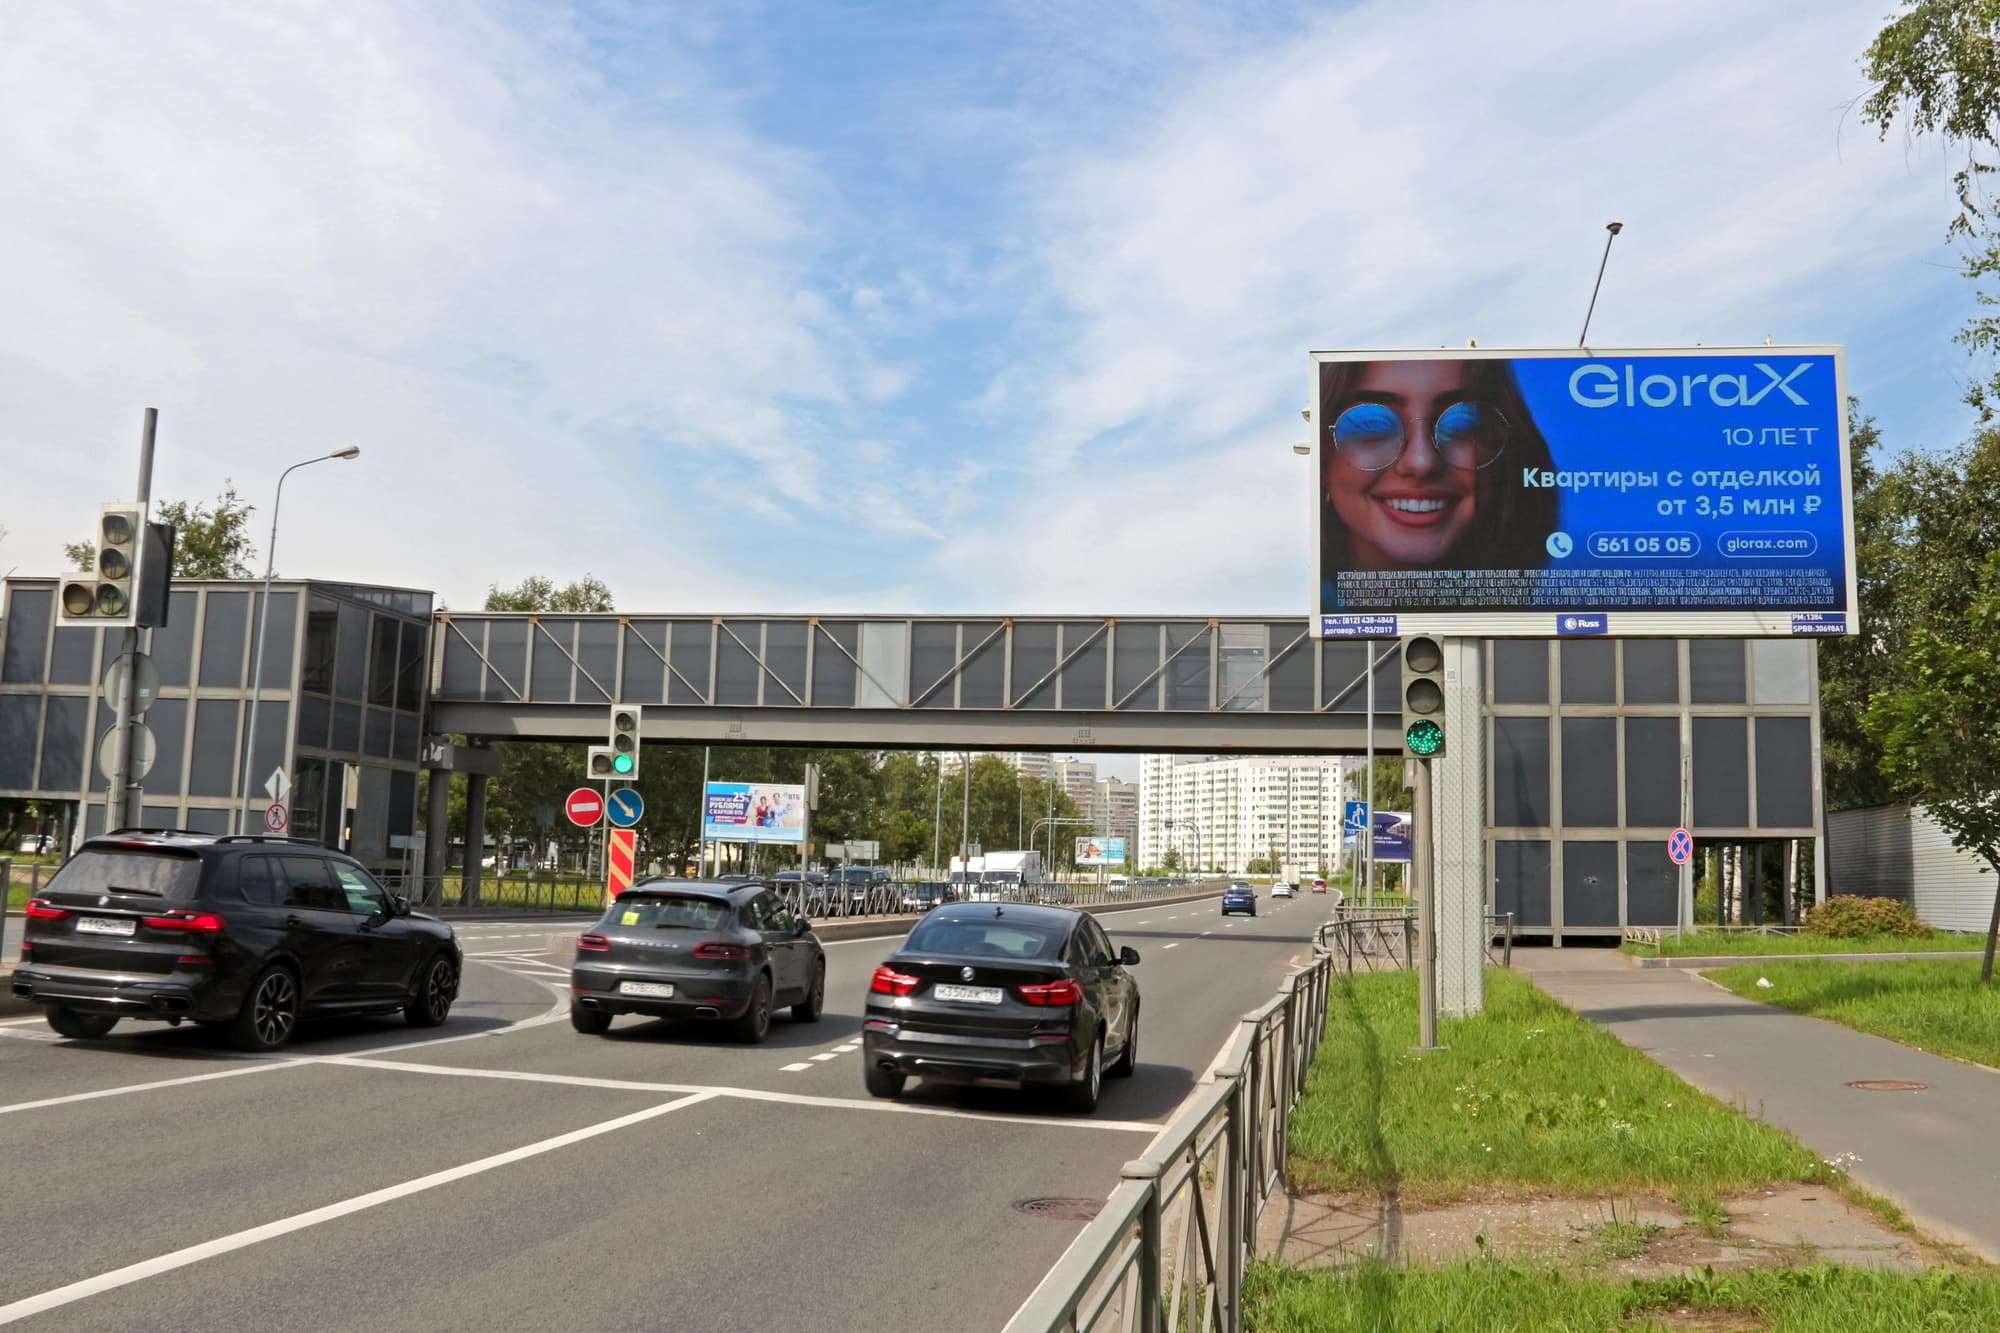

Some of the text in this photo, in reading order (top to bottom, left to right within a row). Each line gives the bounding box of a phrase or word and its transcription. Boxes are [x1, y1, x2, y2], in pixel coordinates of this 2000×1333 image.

[1568, 362, 1815, 408] GloraX
[1722, 427, 1820, 446] 10 ЛЕТ
[1522, 464, 1821, 493] Квартиры с отделкой
[1657, 499, 1686, 516] от
[1695, 495, 1734, 519] 3,5
[1743, 498, 1795, 515] млн
[1597, 537, 1691, 553] 561 05 05
[1727, 538, 1808, 552] glorax.com
[1578, 619, 1600, 628] Russ
